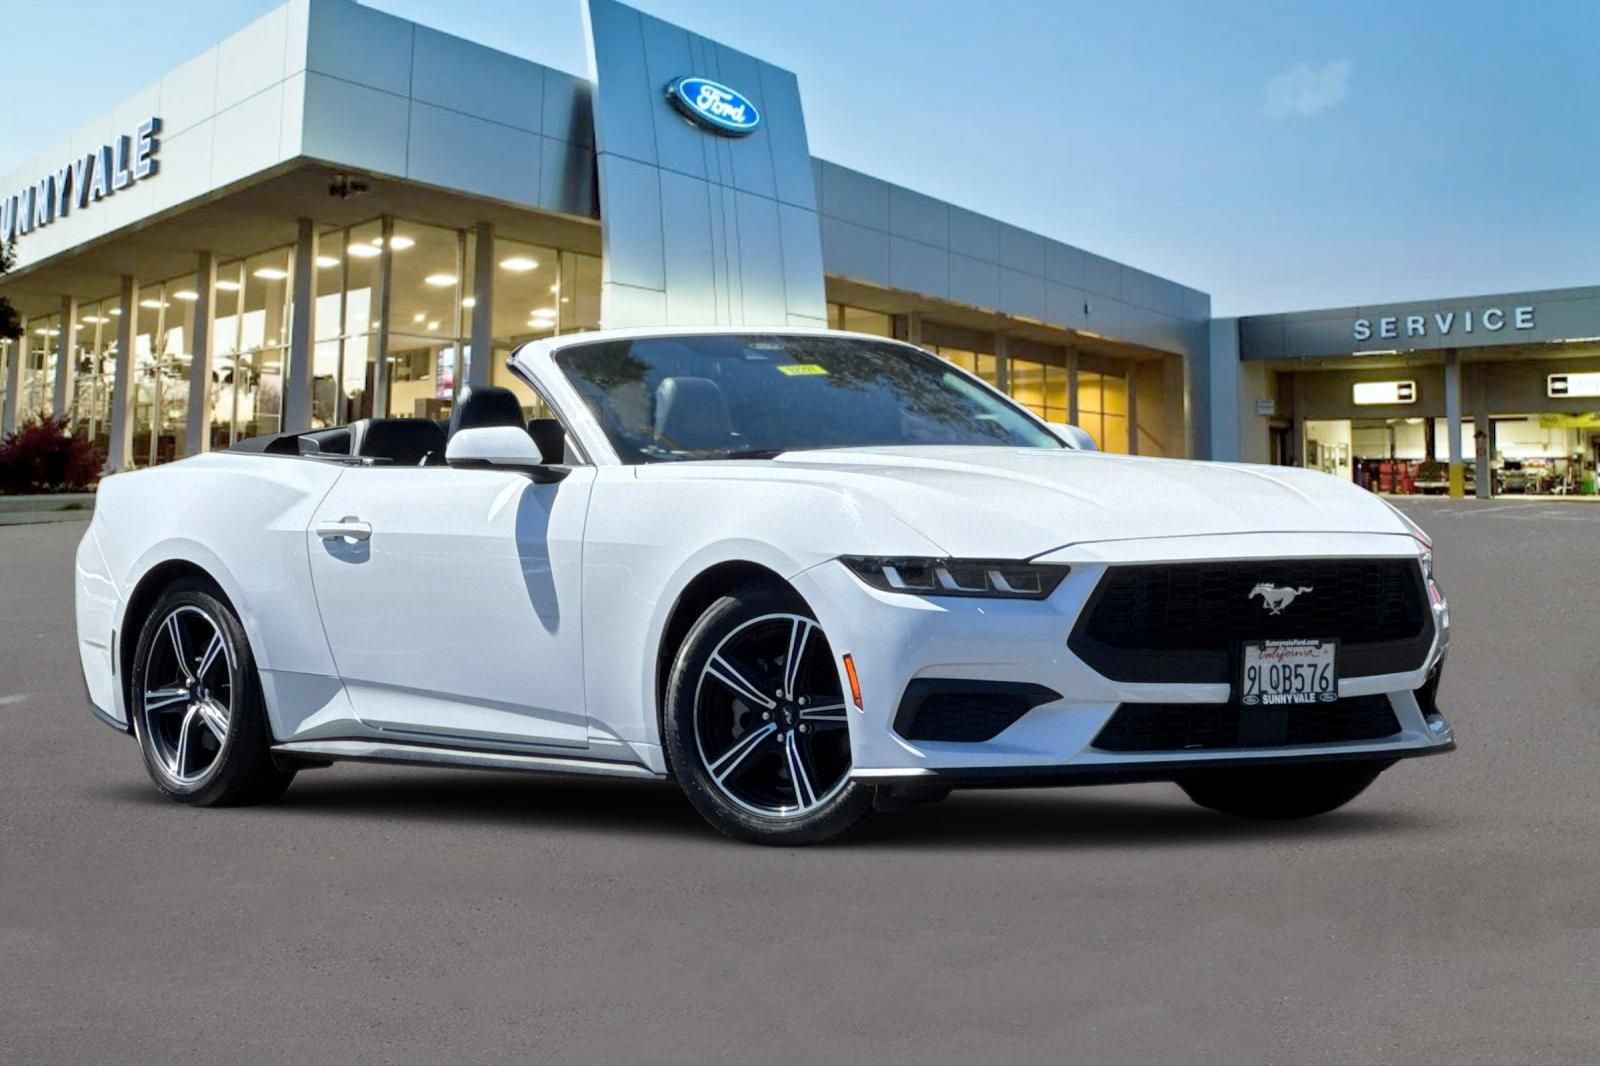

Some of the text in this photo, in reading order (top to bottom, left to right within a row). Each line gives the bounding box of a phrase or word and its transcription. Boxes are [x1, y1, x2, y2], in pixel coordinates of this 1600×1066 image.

[696, 85, 746, 122] Ford
[0, 117, 162, 244] UNNYVALE
[1353, 306, 1535, 340] SERVICE
[1247, 663, 1330, 694] 9LQB576
[1262, 693, 1316, 704] SUNNYVALE
